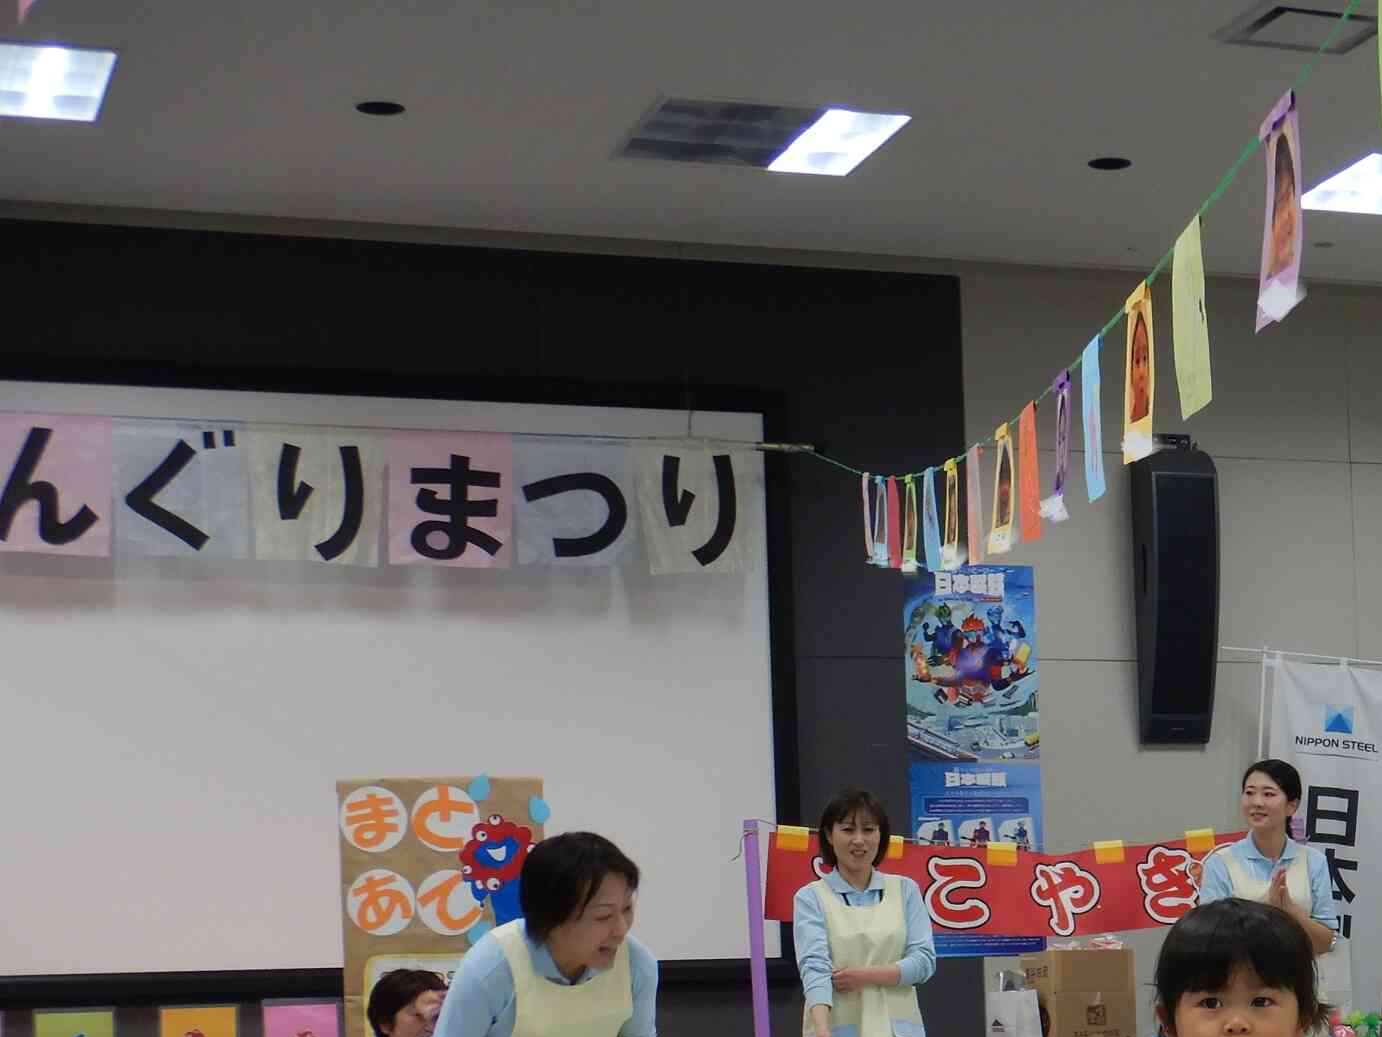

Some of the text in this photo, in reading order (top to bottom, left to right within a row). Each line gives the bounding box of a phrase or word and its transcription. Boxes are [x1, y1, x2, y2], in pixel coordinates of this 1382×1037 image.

[0, 427, 737, 566] んぐりまつり
[1295, 735, 1380, 754] NIPPON STEEL
[344, 783, 475, 849] まと
[351, 870, 482, 931] あて
[812, 844, 1199, 937] こやき
[1305, 785, 1359, 940] 日本
